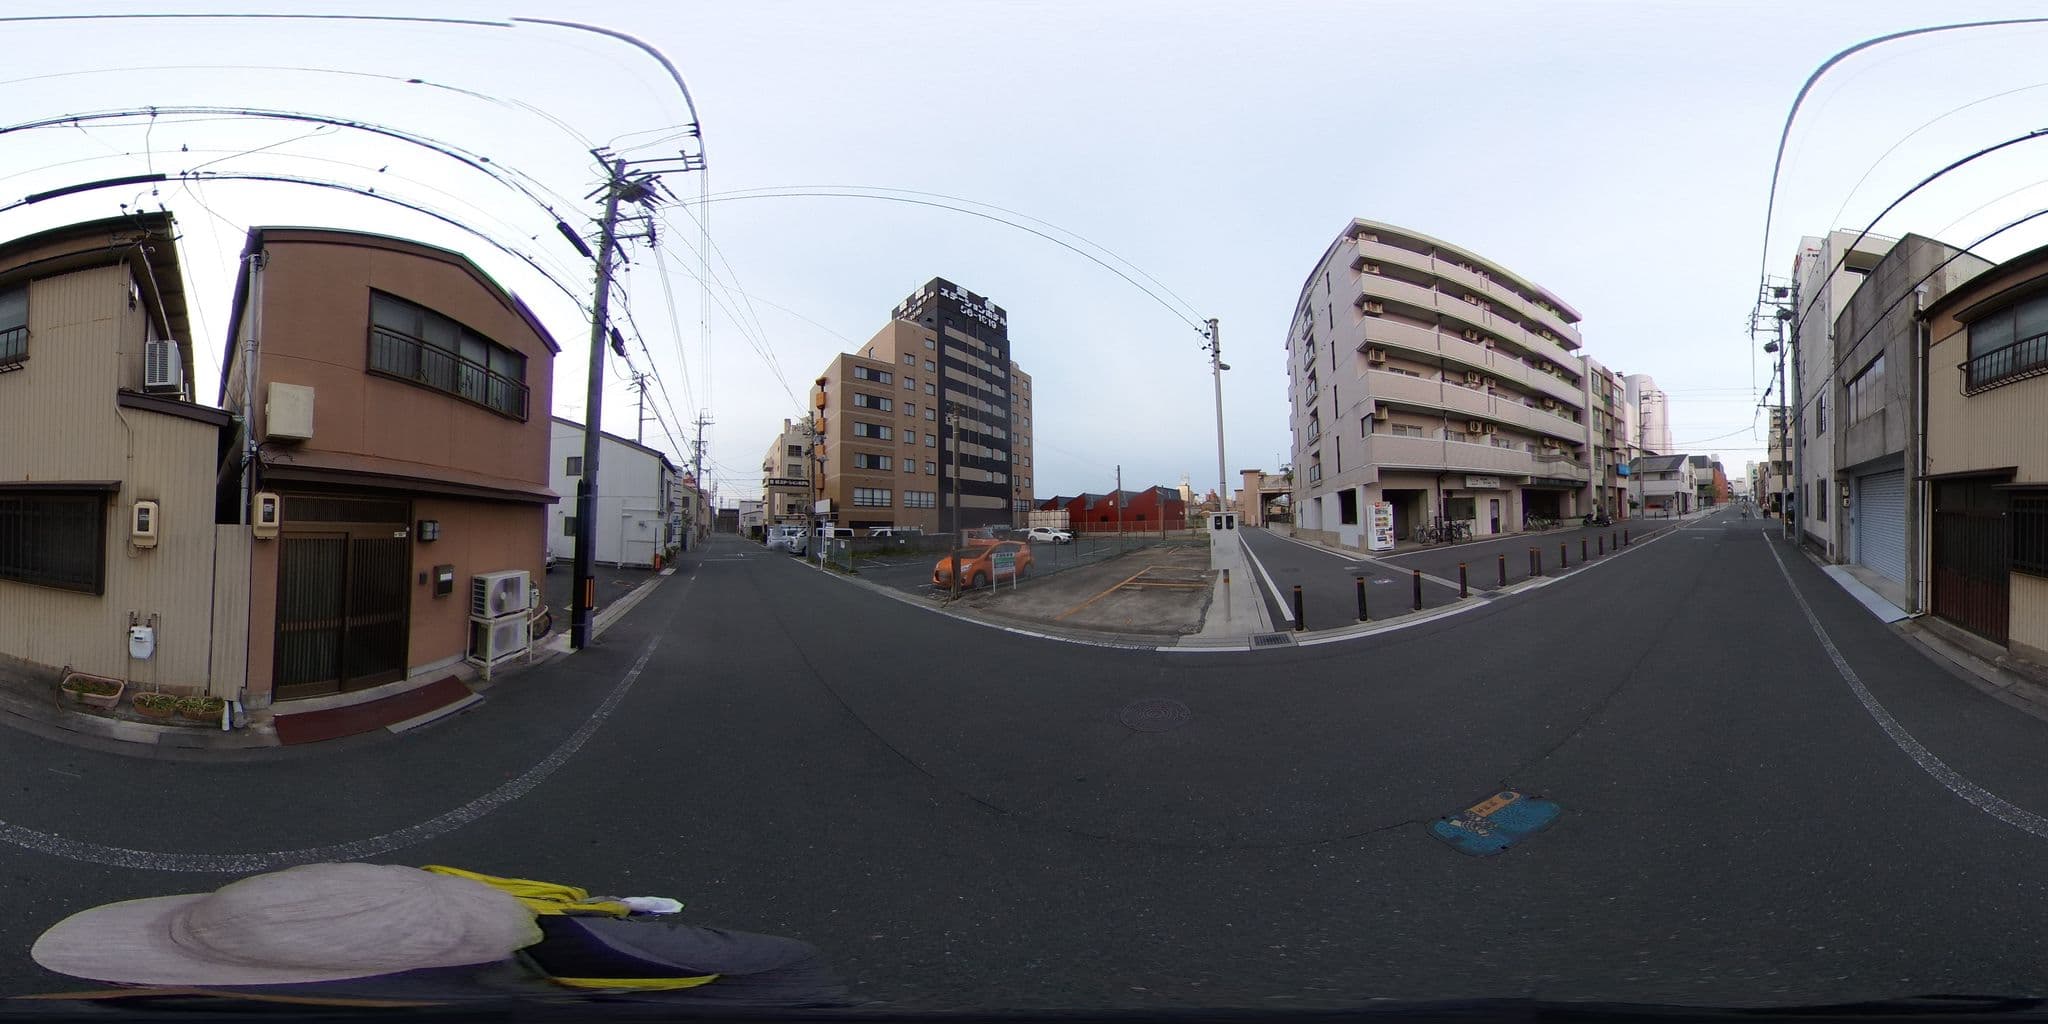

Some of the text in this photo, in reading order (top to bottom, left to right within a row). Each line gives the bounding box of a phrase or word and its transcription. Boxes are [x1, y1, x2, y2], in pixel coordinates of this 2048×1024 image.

[940, 287, 1007, 326] ステーションホテル
